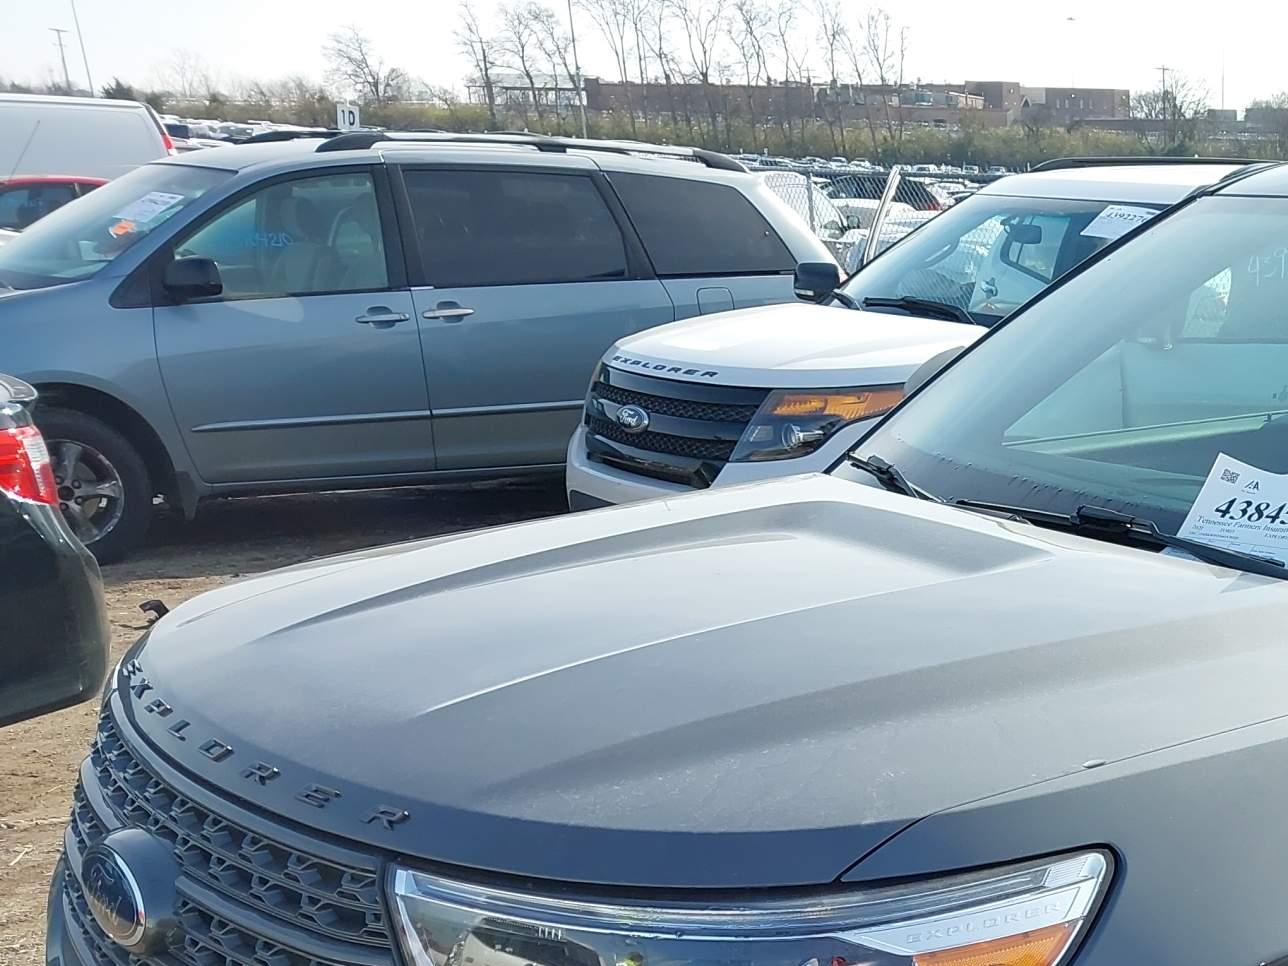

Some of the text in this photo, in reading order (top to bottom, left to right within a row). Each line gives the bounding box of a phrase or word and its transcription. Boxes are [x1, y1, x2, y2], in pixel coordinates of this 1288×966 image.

[612, 355, 719, 378] EXPLORER
[121, 658, 412, 832] EXPLORER
[906, 904, 1061, 943] EXPLORER
